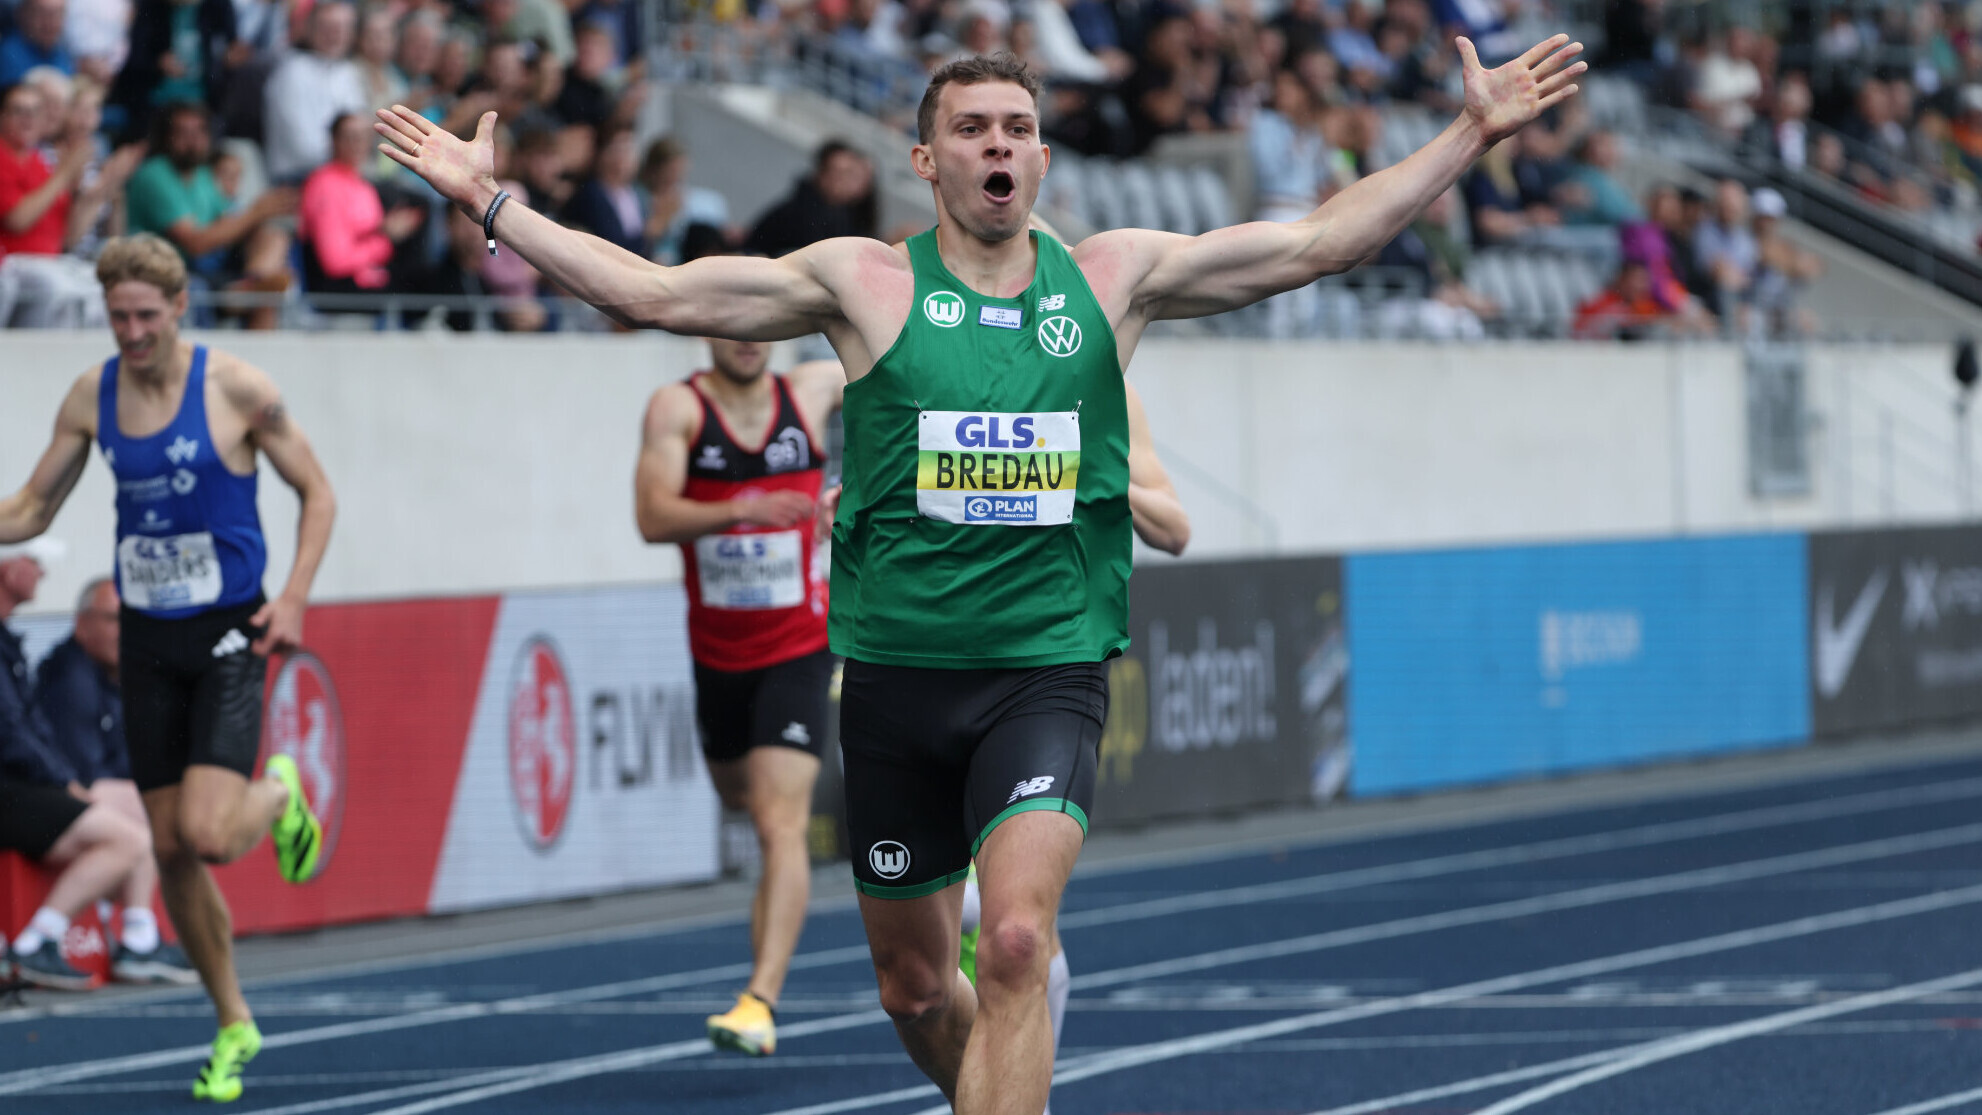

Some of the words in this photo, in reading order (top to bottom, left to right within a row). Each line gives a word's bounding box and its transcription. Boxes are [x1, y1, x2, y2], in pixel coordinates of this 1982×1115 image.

[982, 317, 1019, 328] Bundeswehr
[936, 452, 1064, 490] BREDAU
[994, 500, 1034, 513] PLAN
